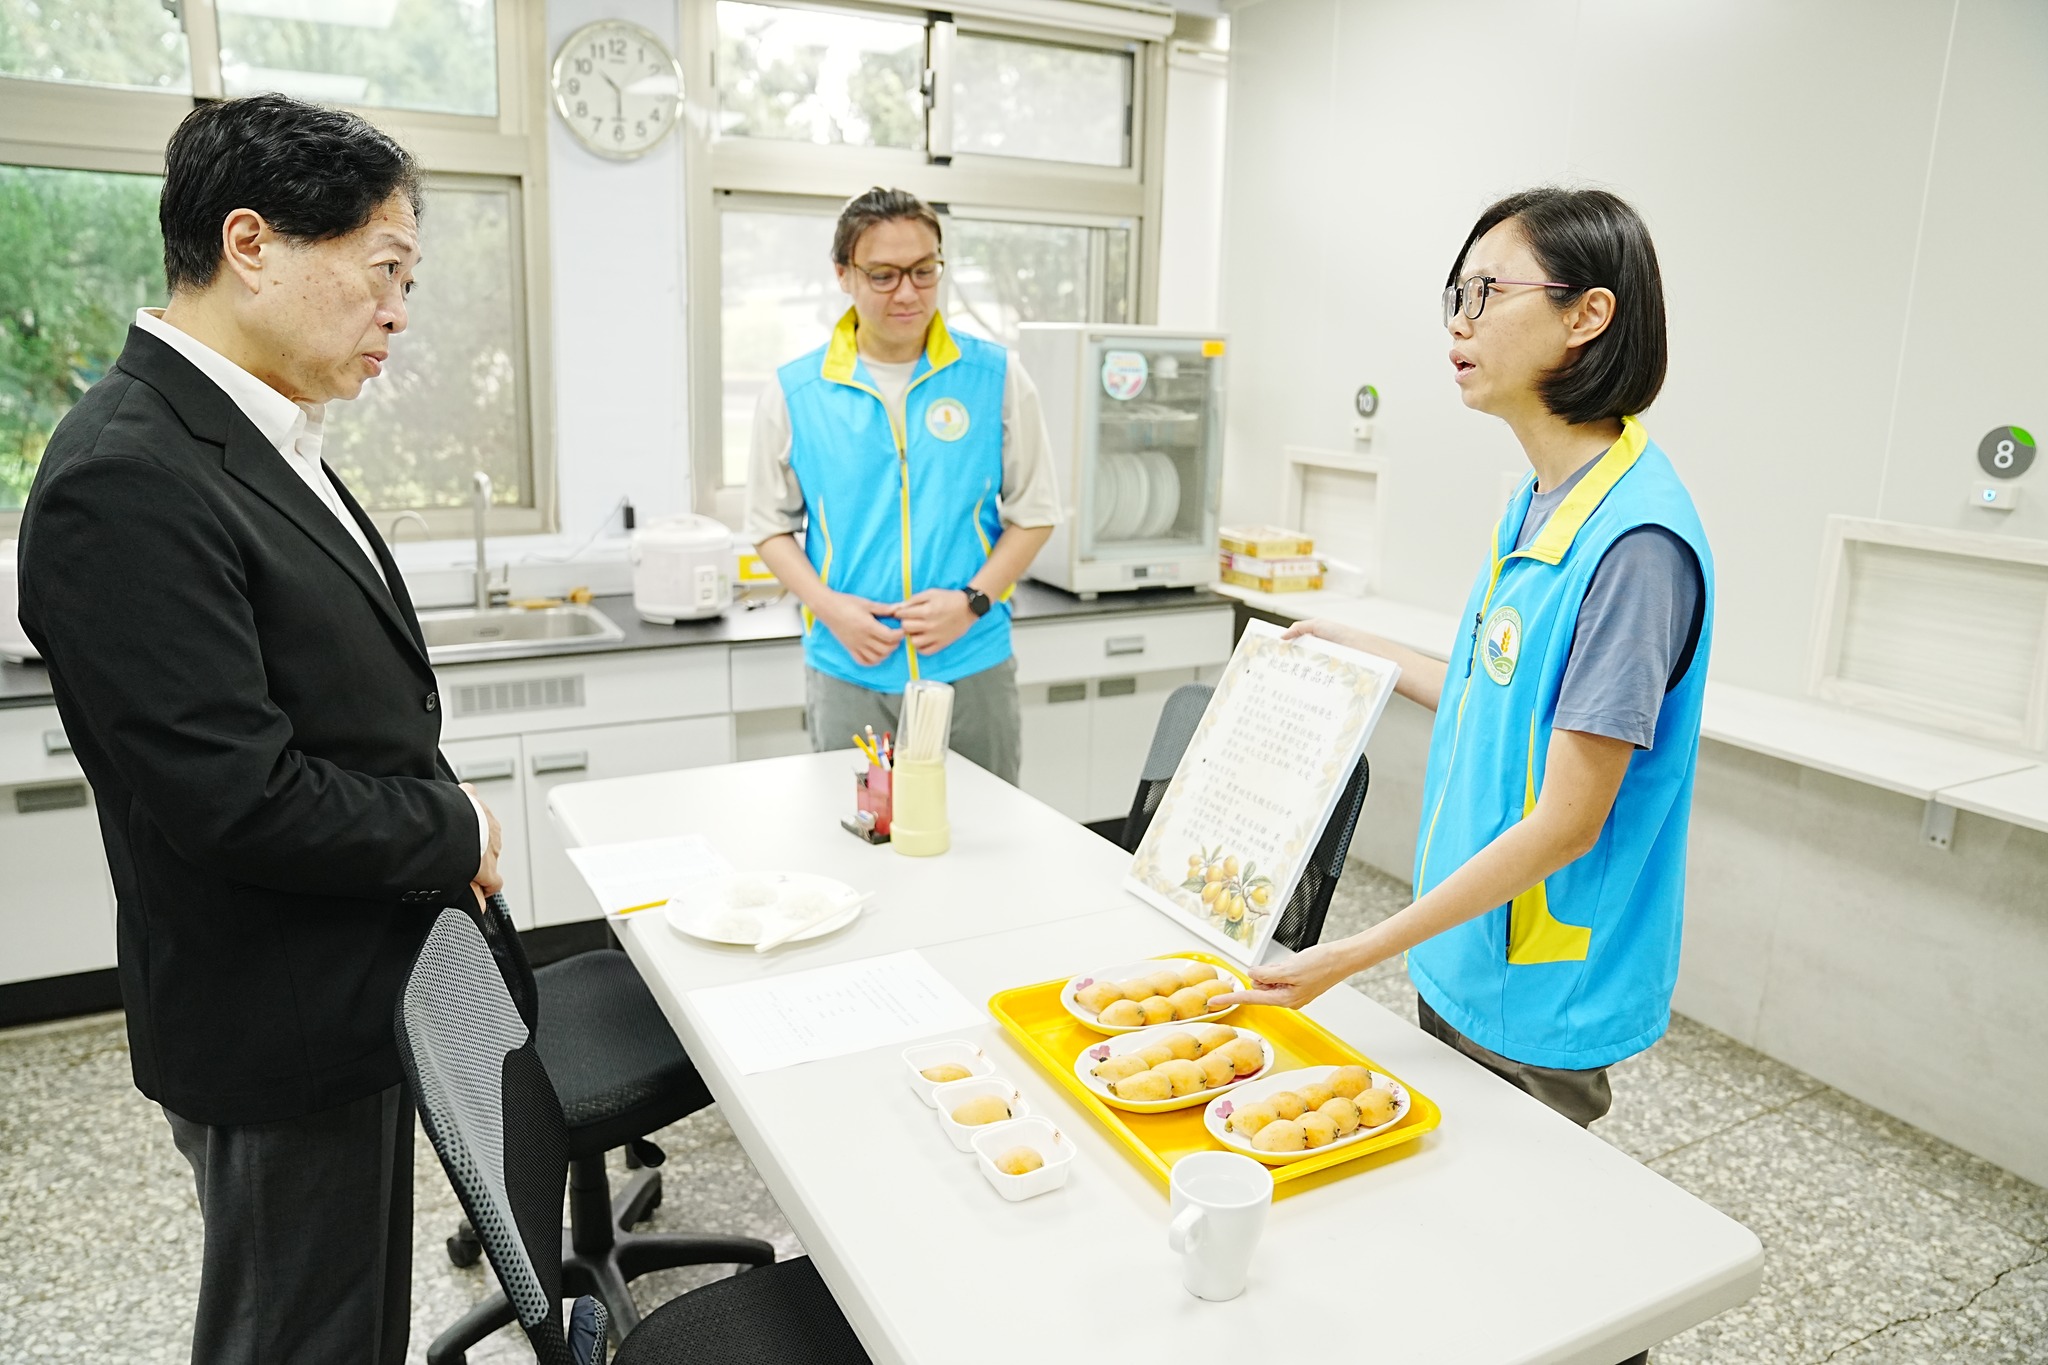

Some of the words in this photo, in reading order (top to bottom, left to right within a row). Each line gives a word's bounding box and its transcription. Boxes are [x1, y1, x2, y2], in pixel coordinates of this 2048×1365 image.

[590, 43, 605, 60] 11
[608, 38, 627, 56] 12
[638, 48, 644, 63] 1
[575, 58, 593, 75] 10
[567, 77, 581, 95] 9
[575, 101, 588, 118] 8
[649, 107, 660, 122] 4
[592, 116, 603, 133] 7
[613, 124, 625, 142] 6
[634, 120, 647, 137] 5
[1359, 392, 1374, 412] 10
[1994, 440, 2015, 469] 8
